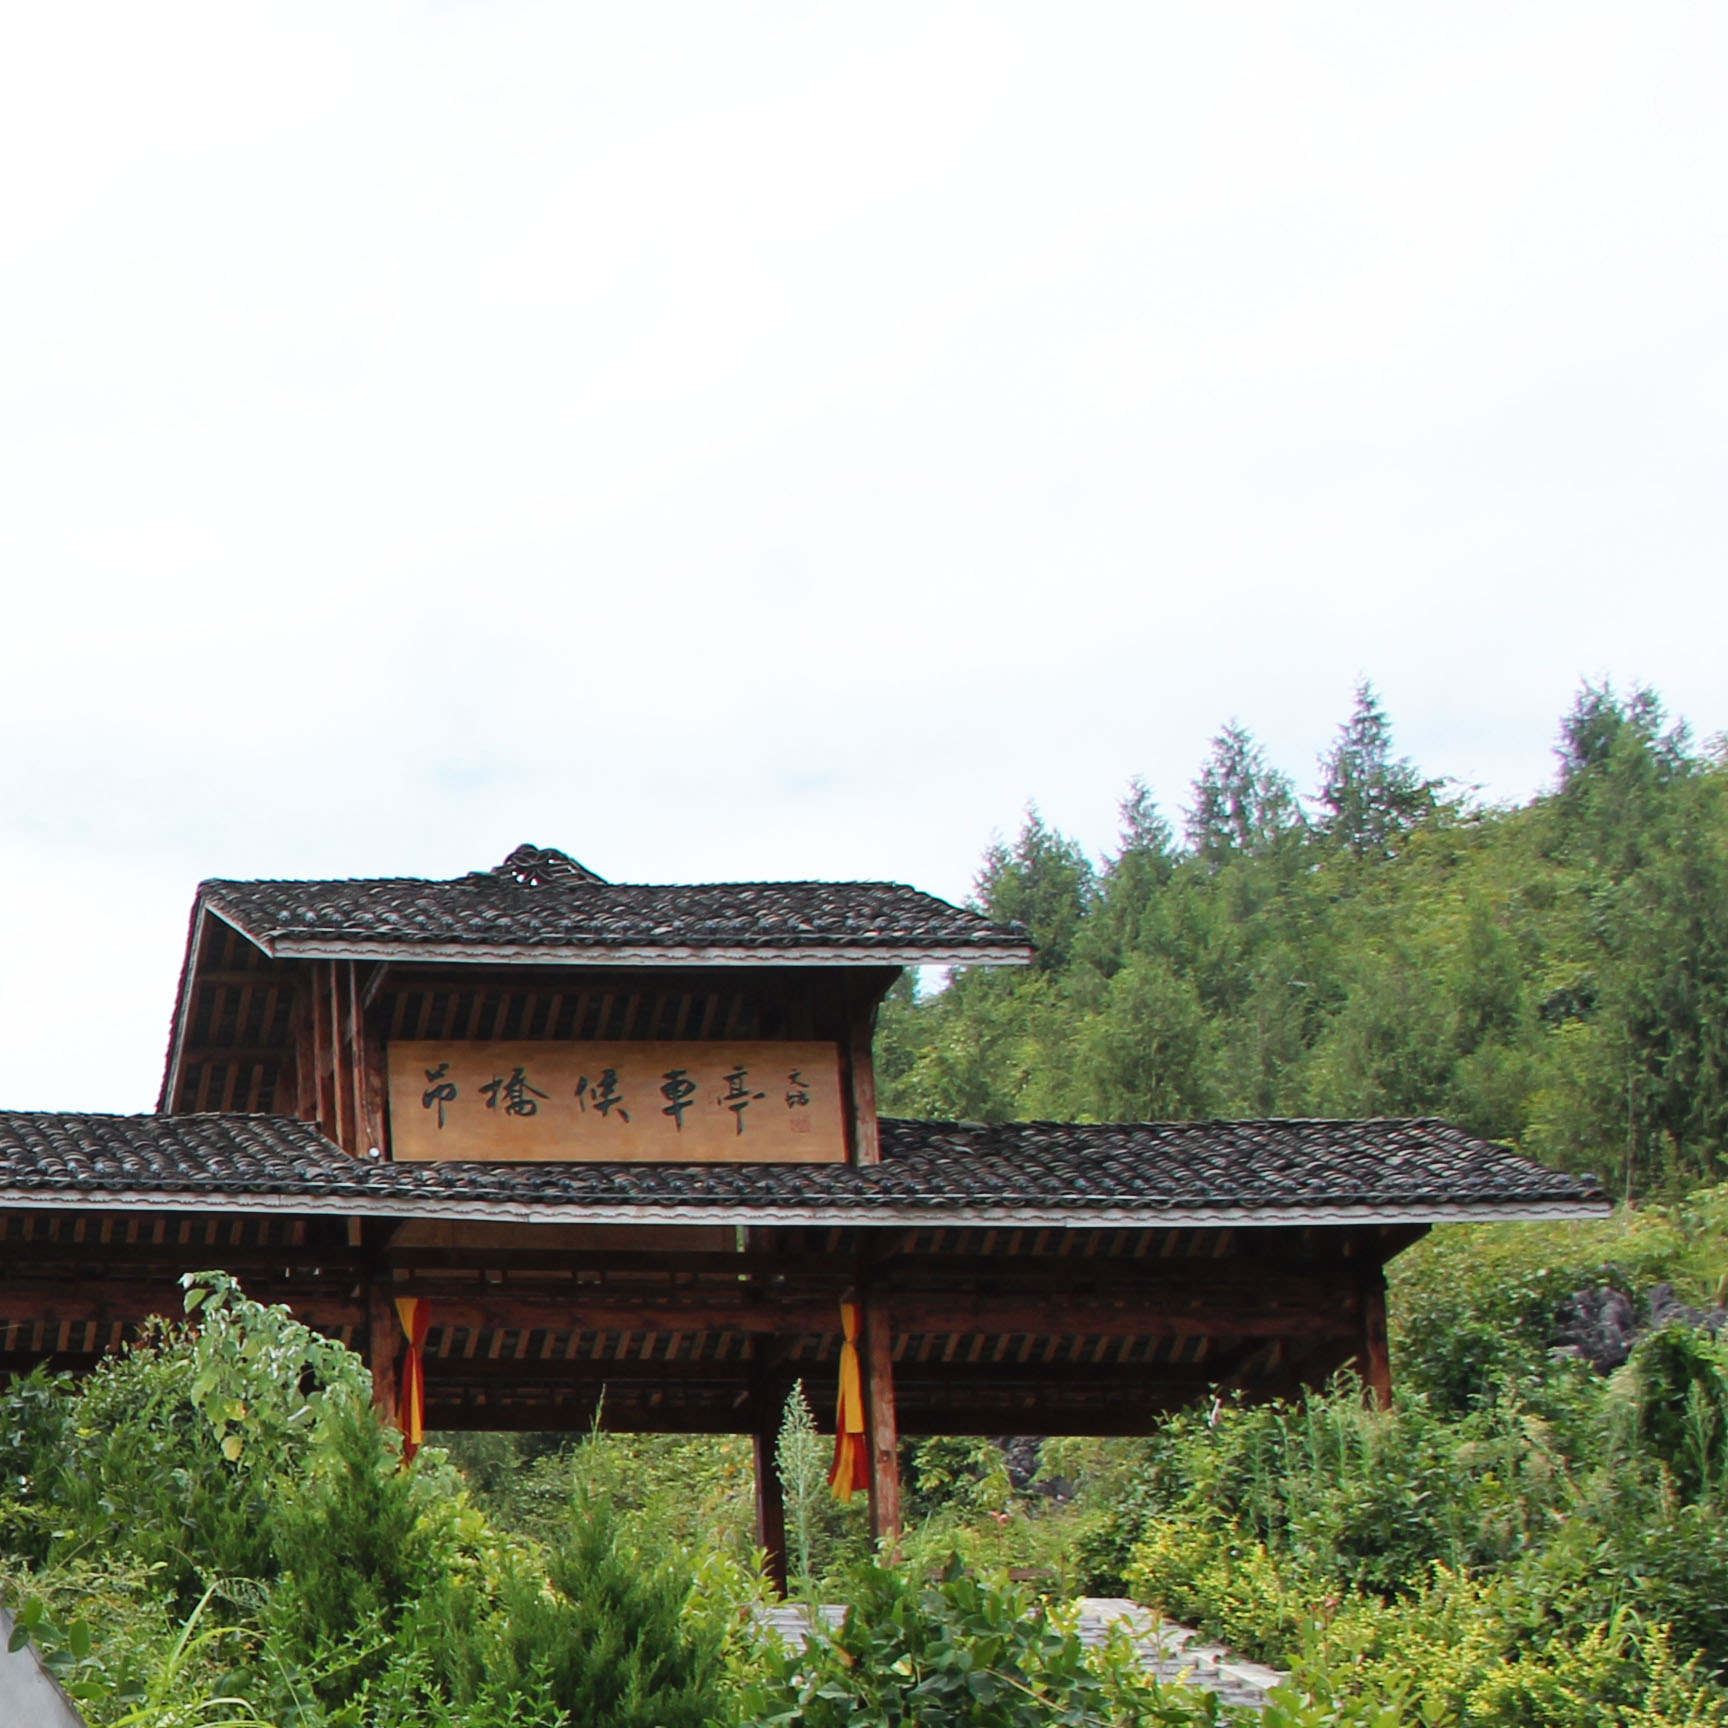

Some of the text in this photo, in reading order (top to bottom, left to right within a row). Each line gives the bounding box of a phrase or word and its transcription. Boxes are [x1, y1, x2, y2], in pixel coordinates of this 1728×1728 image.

[421, 1063, 766, 1136] 吊橋候車亭
